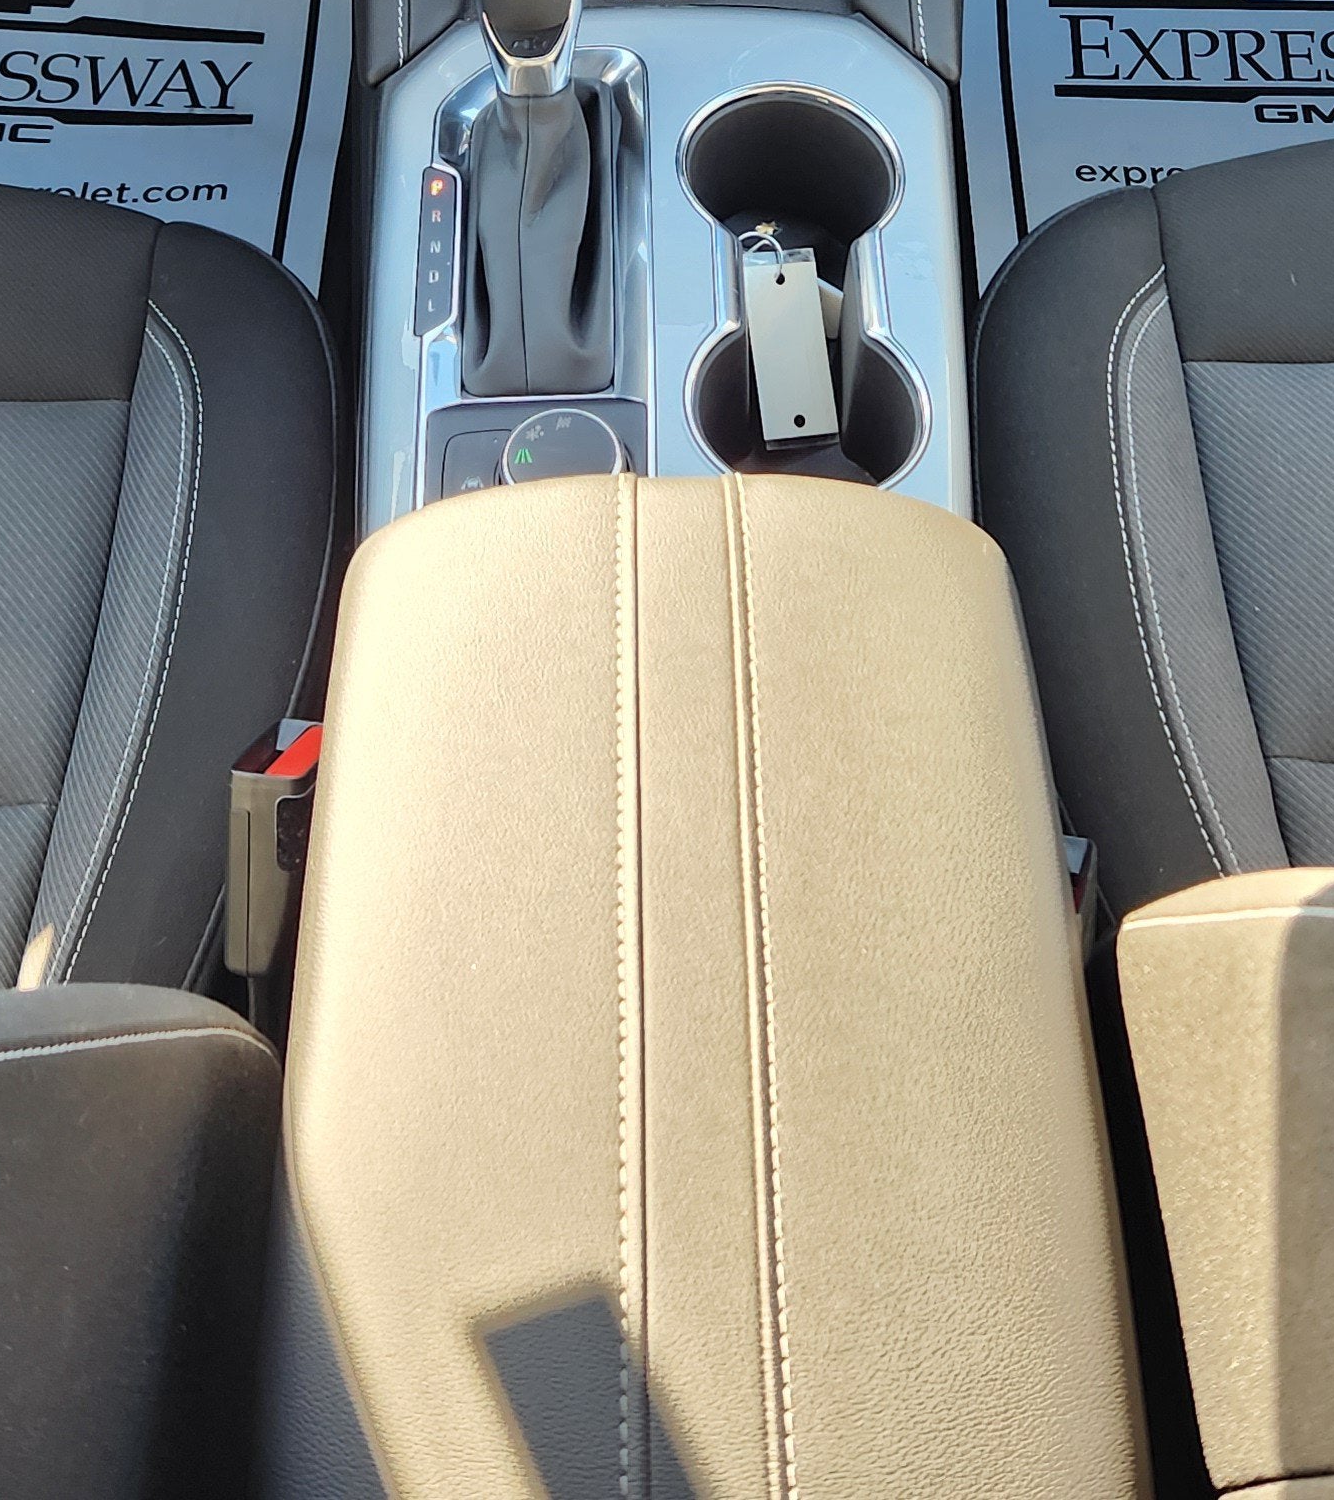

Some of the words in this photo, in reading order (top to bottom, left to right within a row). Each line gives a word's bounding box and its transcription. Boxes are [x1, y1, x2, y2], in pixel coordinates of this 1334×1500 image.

[430, 179, 444, 196] P
[431, 209, 442, 223] R
[430, 240, 441, 254] N
[428, 269, 440, 283] D
[427, 299, 436, 312] L
